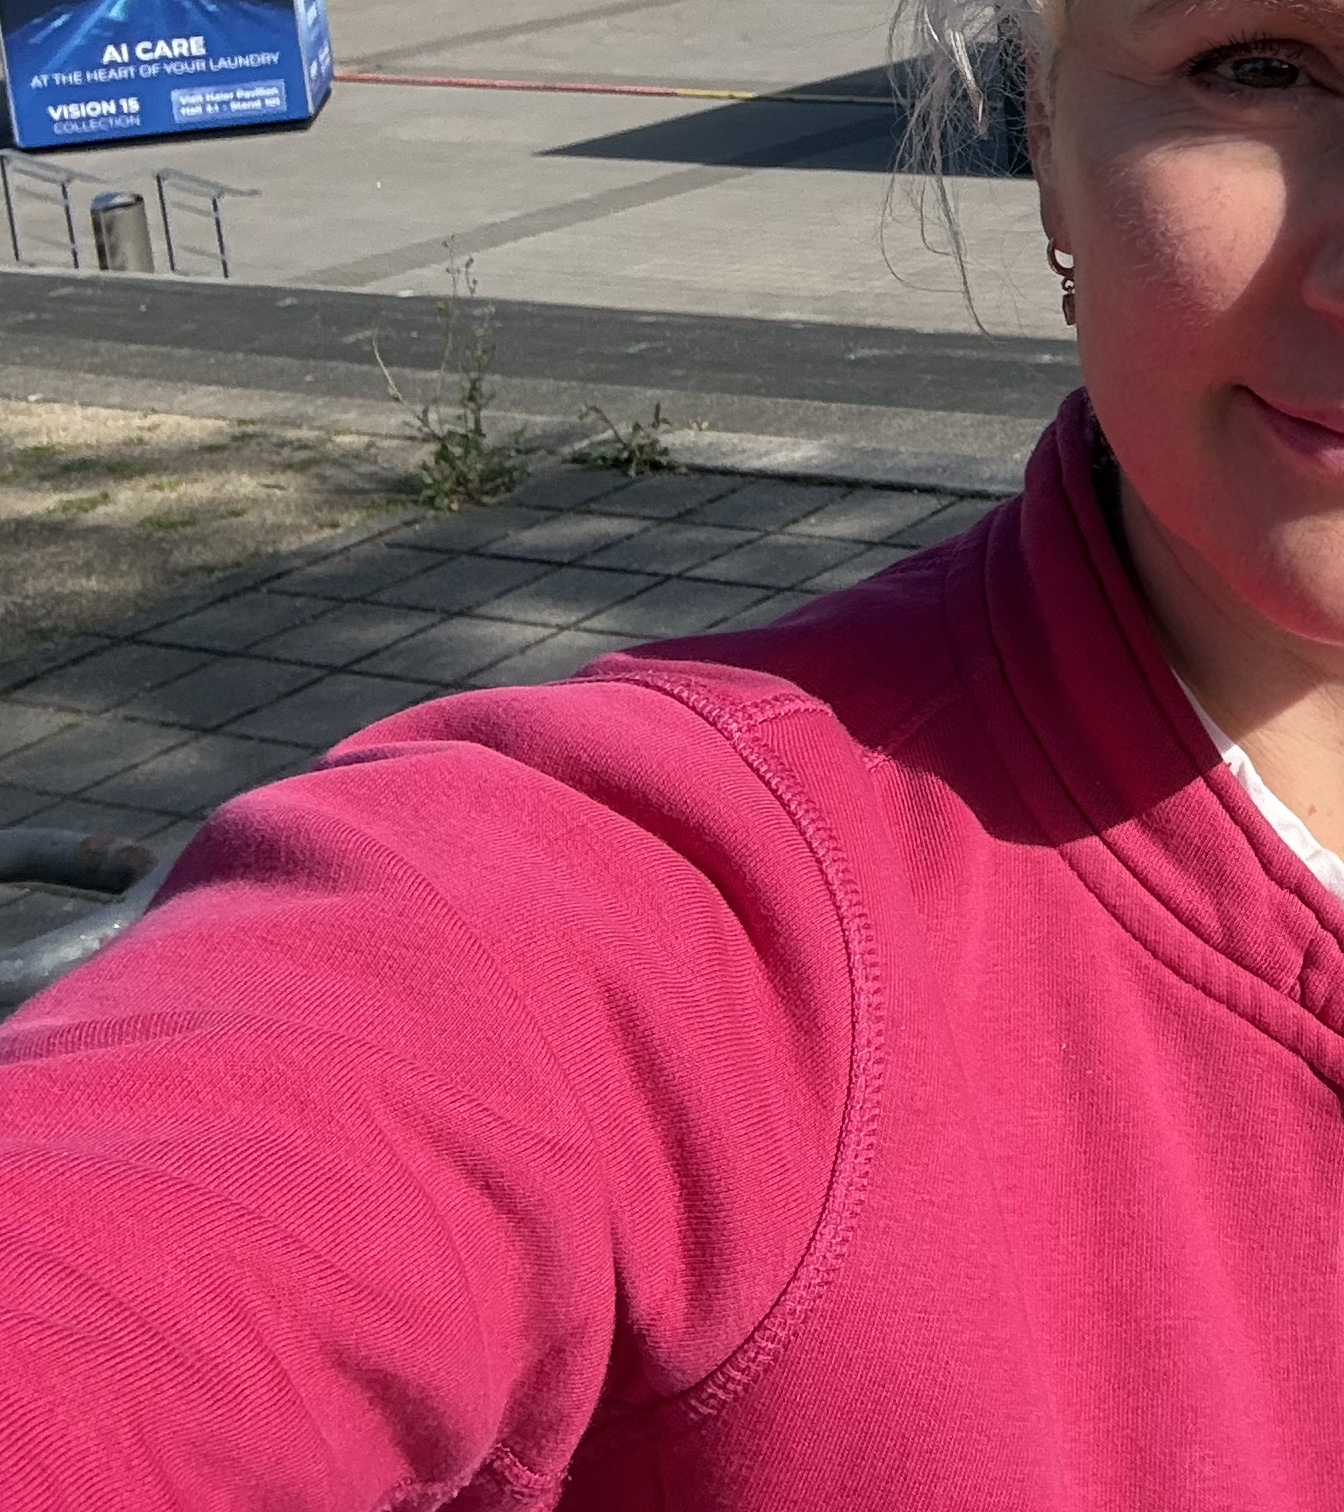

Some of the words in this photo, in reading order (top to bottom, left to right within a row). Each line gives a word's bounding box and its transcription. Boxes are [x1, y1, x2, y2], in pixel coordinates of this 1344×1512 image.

[102, 43, 129, 65] AI
[135, 36, 207, 62] CARE
[30, 74, 49, 89] AT
[54, 71, 83, 86] THE
[86, 66, 136, 83] HEART
[139, 64, 160, 78] OF
[163, 59, 206, 76] YOUR
[210, 52, 280, 71] LAUNDRY
[48, 99, 117, 121] VISION
[53, 115, 140, 134] COLLECTION
